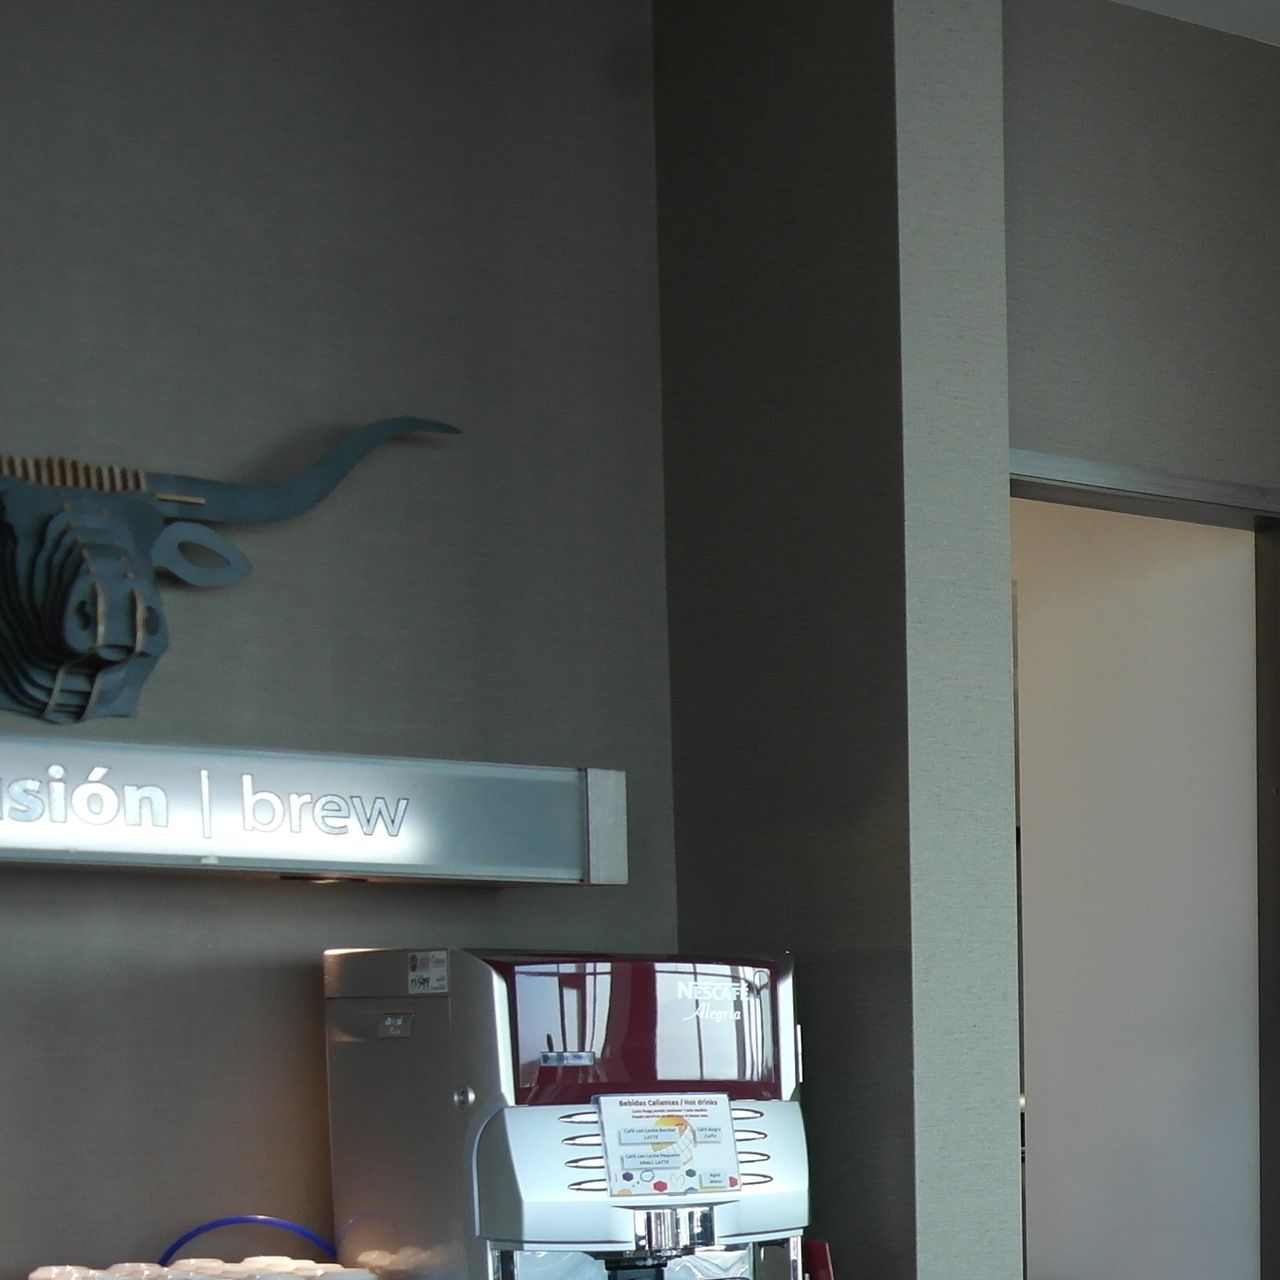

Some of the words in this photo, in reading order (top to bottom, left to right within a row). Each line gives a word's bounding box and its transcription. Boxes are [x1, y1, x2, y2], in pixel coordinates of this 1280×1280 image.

[0, 764, 169, 828] sión
[241, 773, 409, 837] brew
[619, 1098, 646, 1107] Bebidas
[647, 1098, 679, 1106] Calientes
[684, 1098, 696, 1106] Hot
[697, 1098, 718, 1106] drinks
